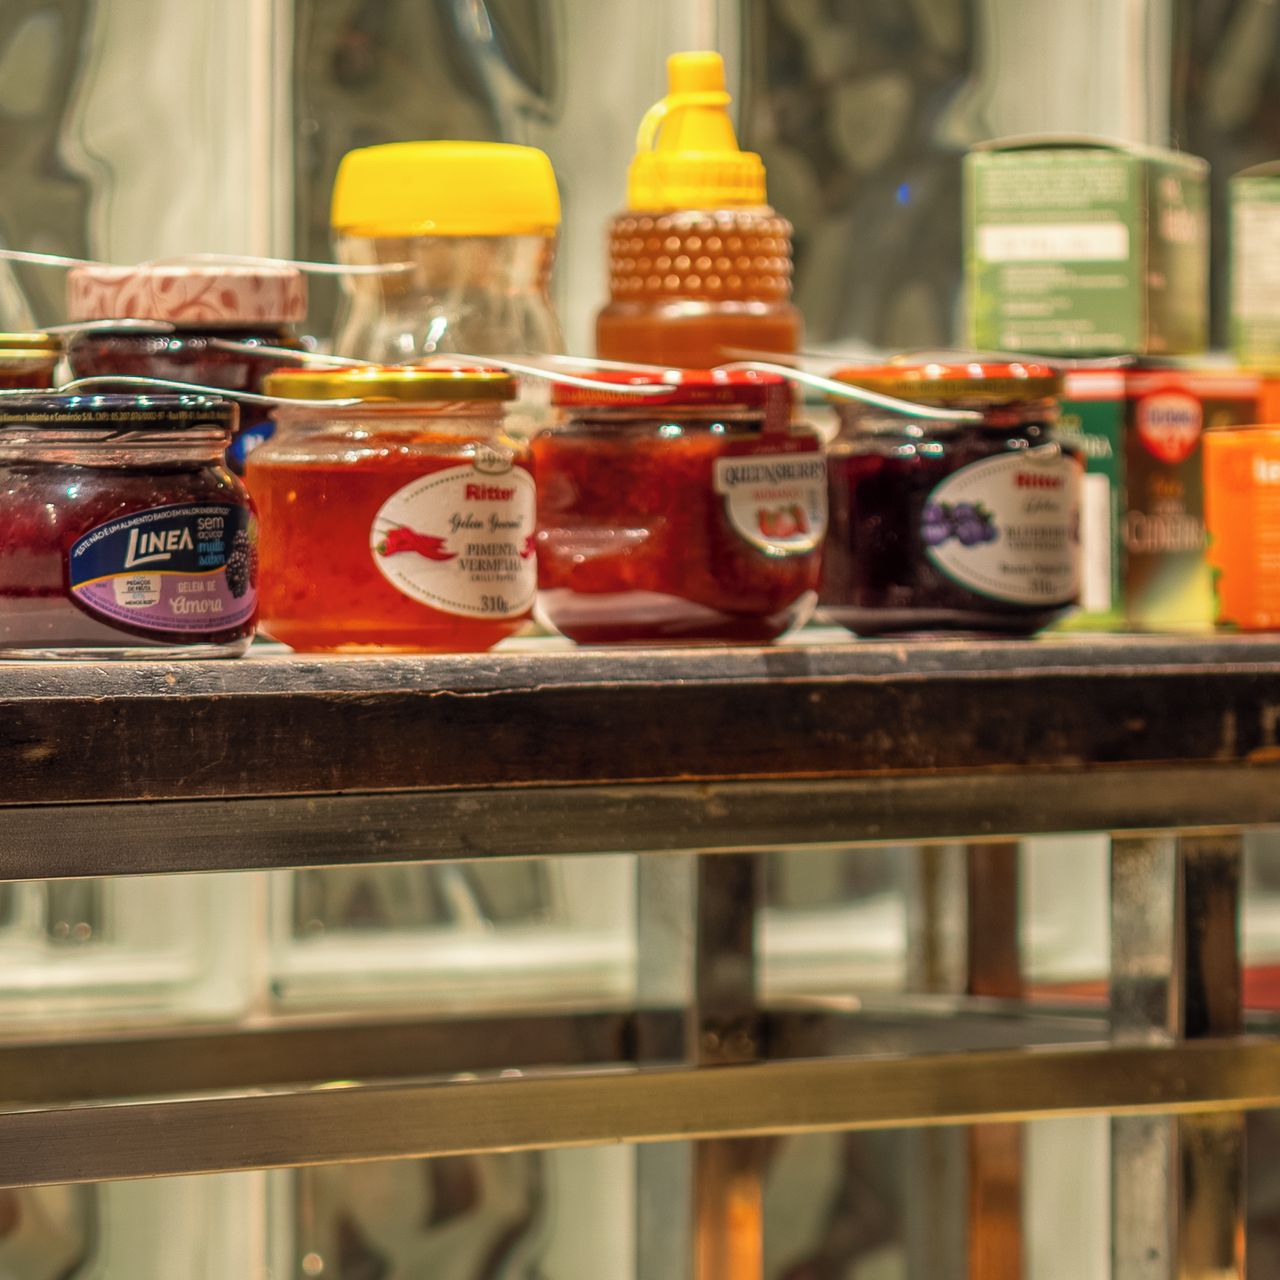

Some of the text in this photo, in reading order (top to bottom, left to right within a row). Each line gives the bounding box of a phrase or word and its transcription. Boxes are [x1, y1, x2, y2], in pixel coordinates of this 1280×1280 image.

[465, 483, 517, 501] Ritter
[197, 516, 225, 530] sem
[125, 527, 194, 569] LINEA
[466, 543, 520, 556] PIMENTA
[459, 558, 523, 572] VERMELHA
[178, 581, 217, 593] GELEIA DE
